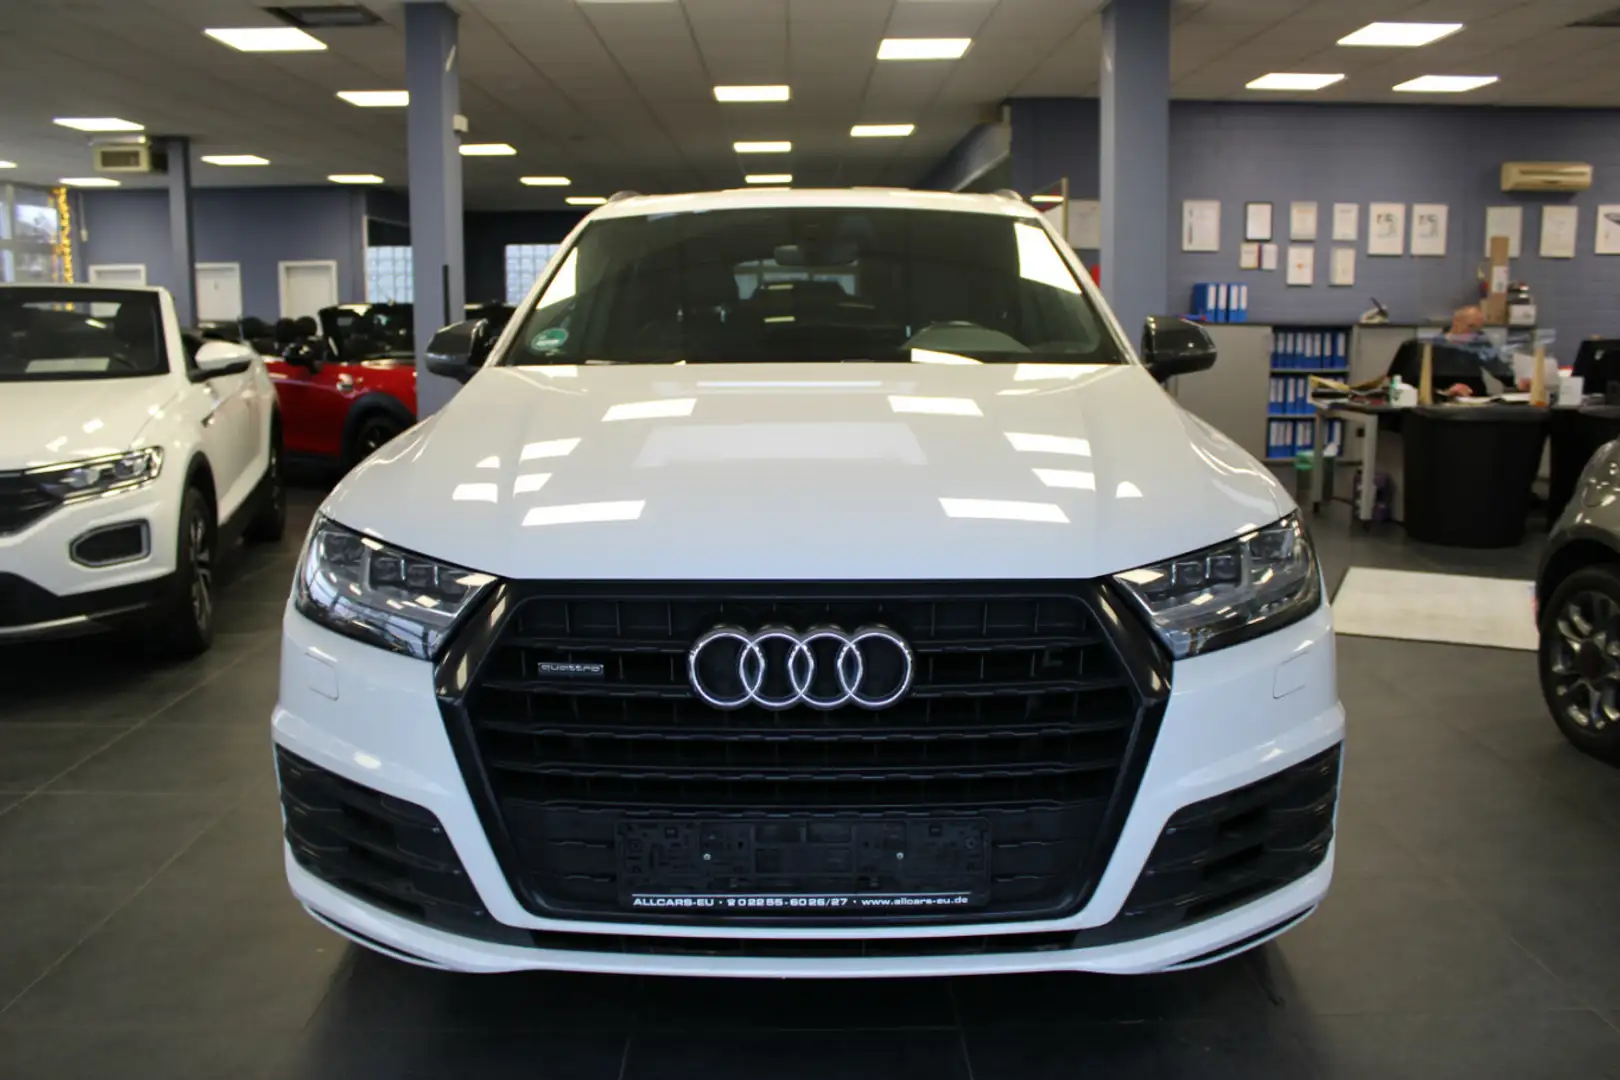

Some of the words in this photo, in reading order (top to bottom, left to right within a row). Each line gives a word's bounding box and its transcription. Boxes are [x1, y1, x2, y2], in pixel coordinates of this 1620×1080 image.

[541, 664, 601, 672] quattro
[633, 898, 714, 907] ALLCARS-EU
[861, 896, 969, 905] www.allcars-eu.de
